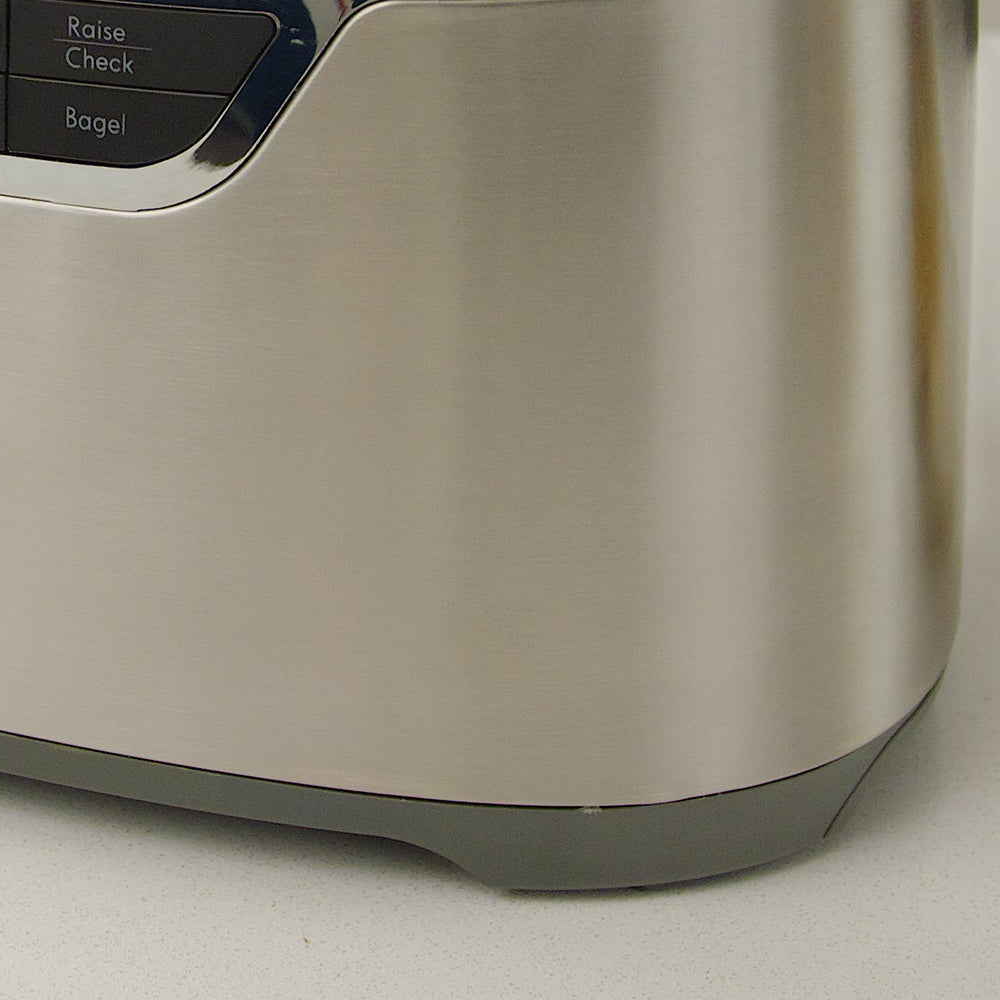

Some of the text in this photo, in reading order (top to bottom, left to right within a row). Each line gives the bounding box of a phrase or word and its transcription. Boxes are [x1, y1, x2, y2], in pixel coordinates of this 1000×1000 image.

[67, 15, 126, 43] Raise
[64, 46, 134, 75] Check
[65, 105, 126, 139] Bagel
